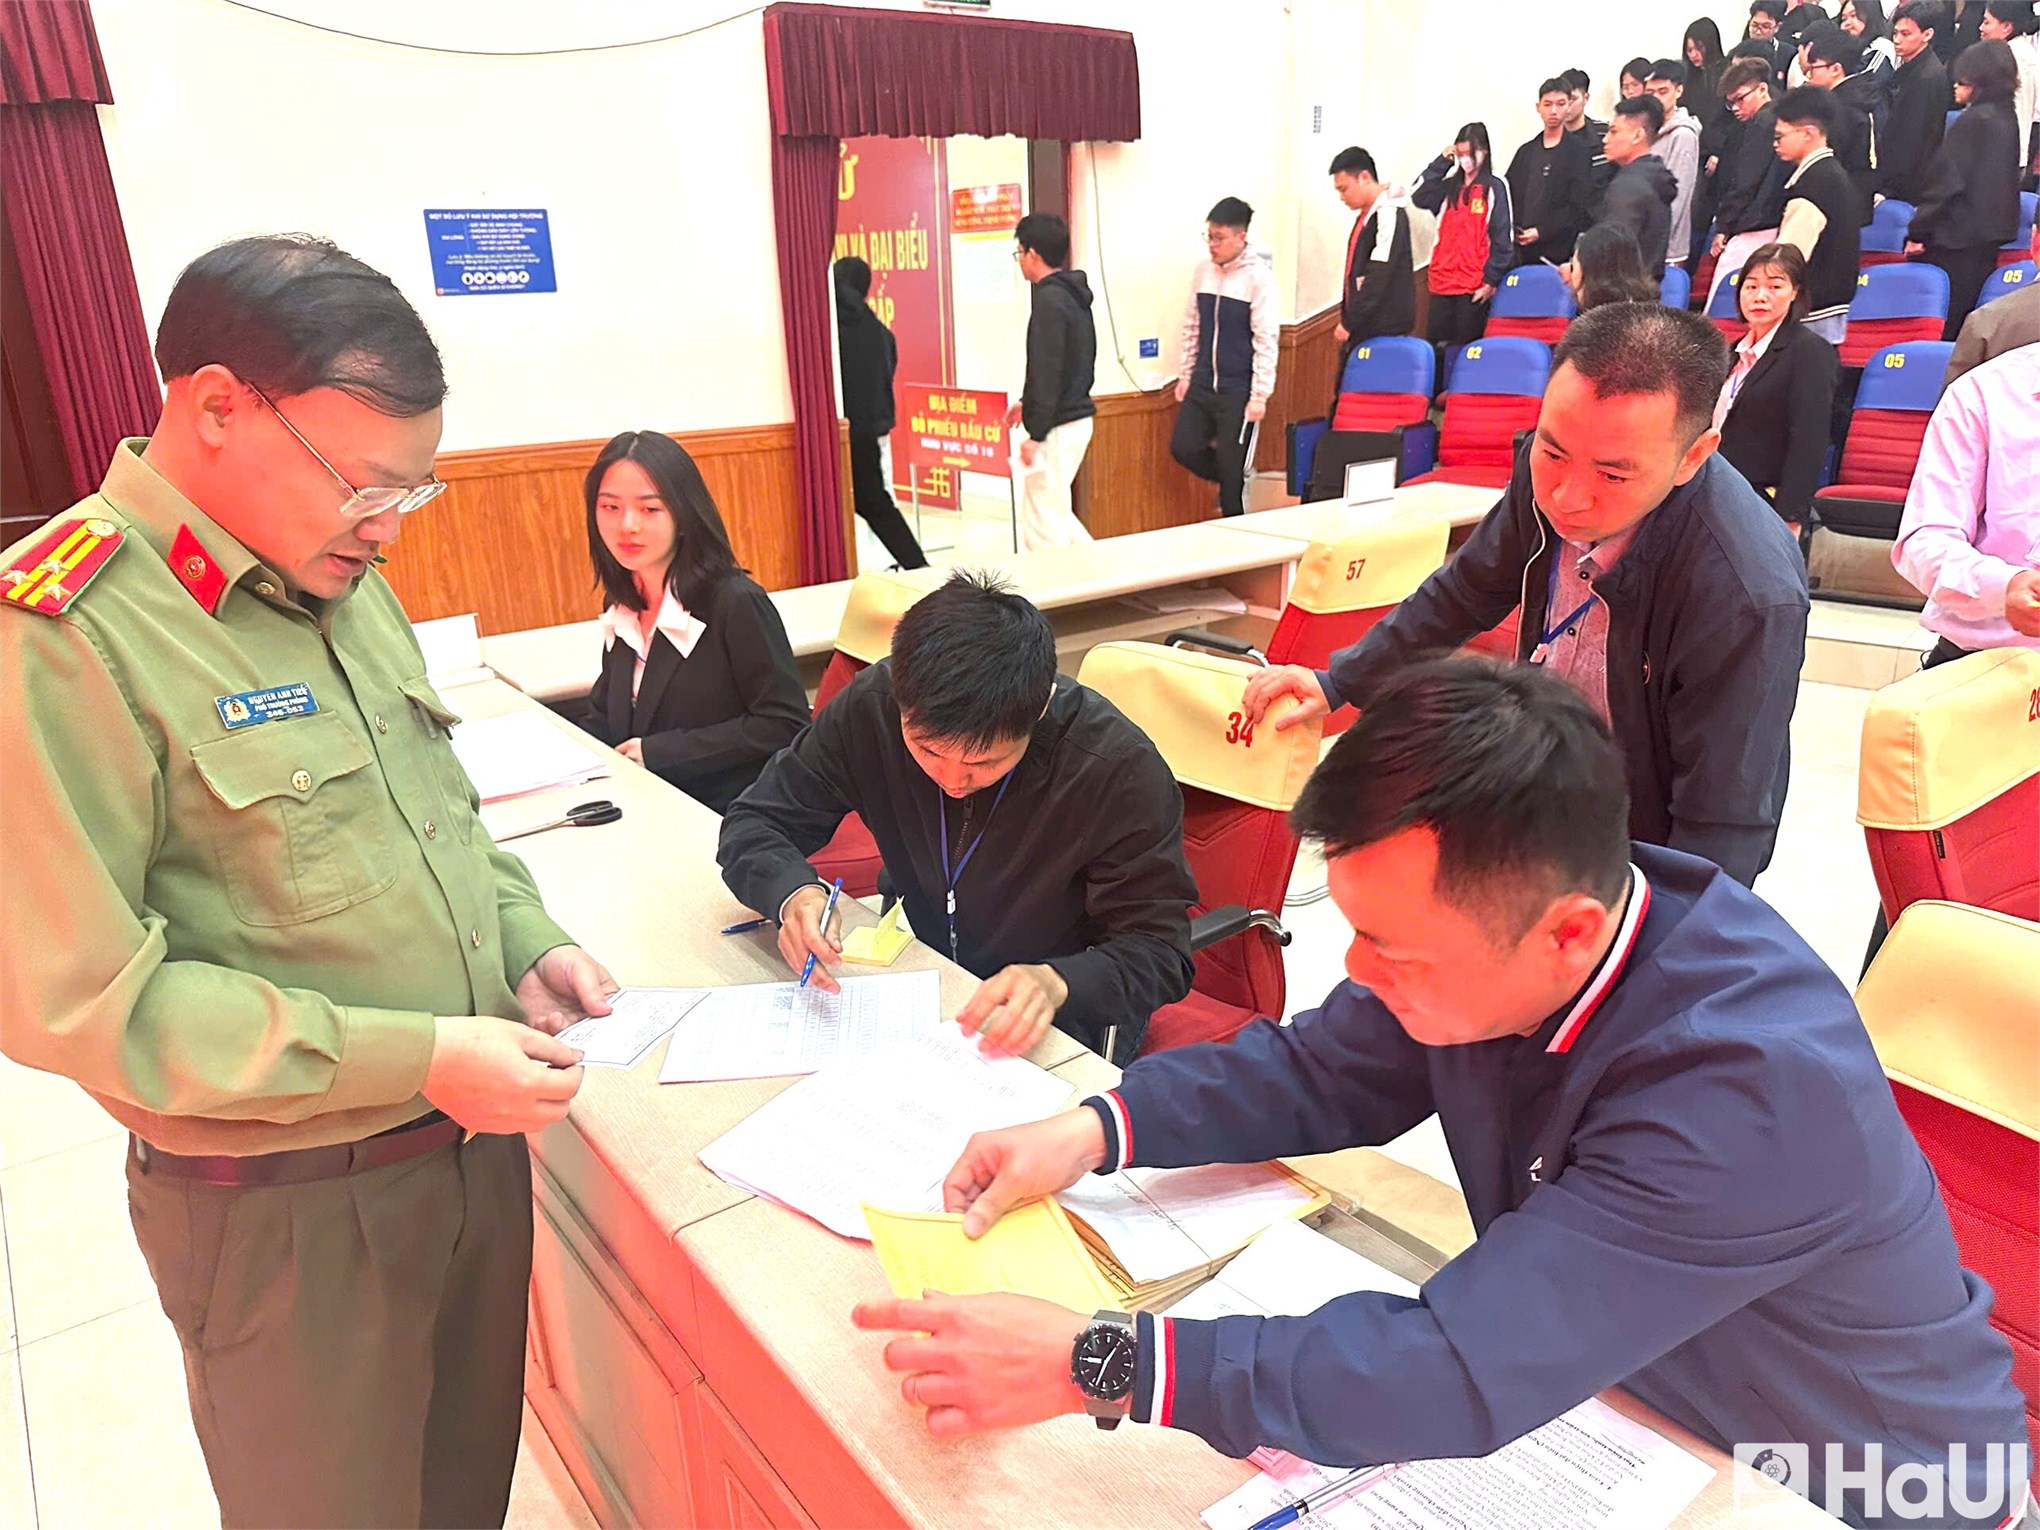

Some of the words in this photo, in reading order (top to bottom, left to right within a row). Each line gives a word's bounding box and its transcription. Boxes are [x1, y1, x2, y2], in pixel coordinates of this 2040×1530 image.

[895, 212, 928, 271] BIỂU
[1506, 275, 1519, 286] 01
[2002, 270, 2022, 282] 05
[1357, 347, 1371, 360] 01
[1466, 346, 1482, 359] 02
[1884, 353, 1905, 368] 05
[1346, 559, 1366, 581] 57
[1226, 711, 1253, 748] 34
